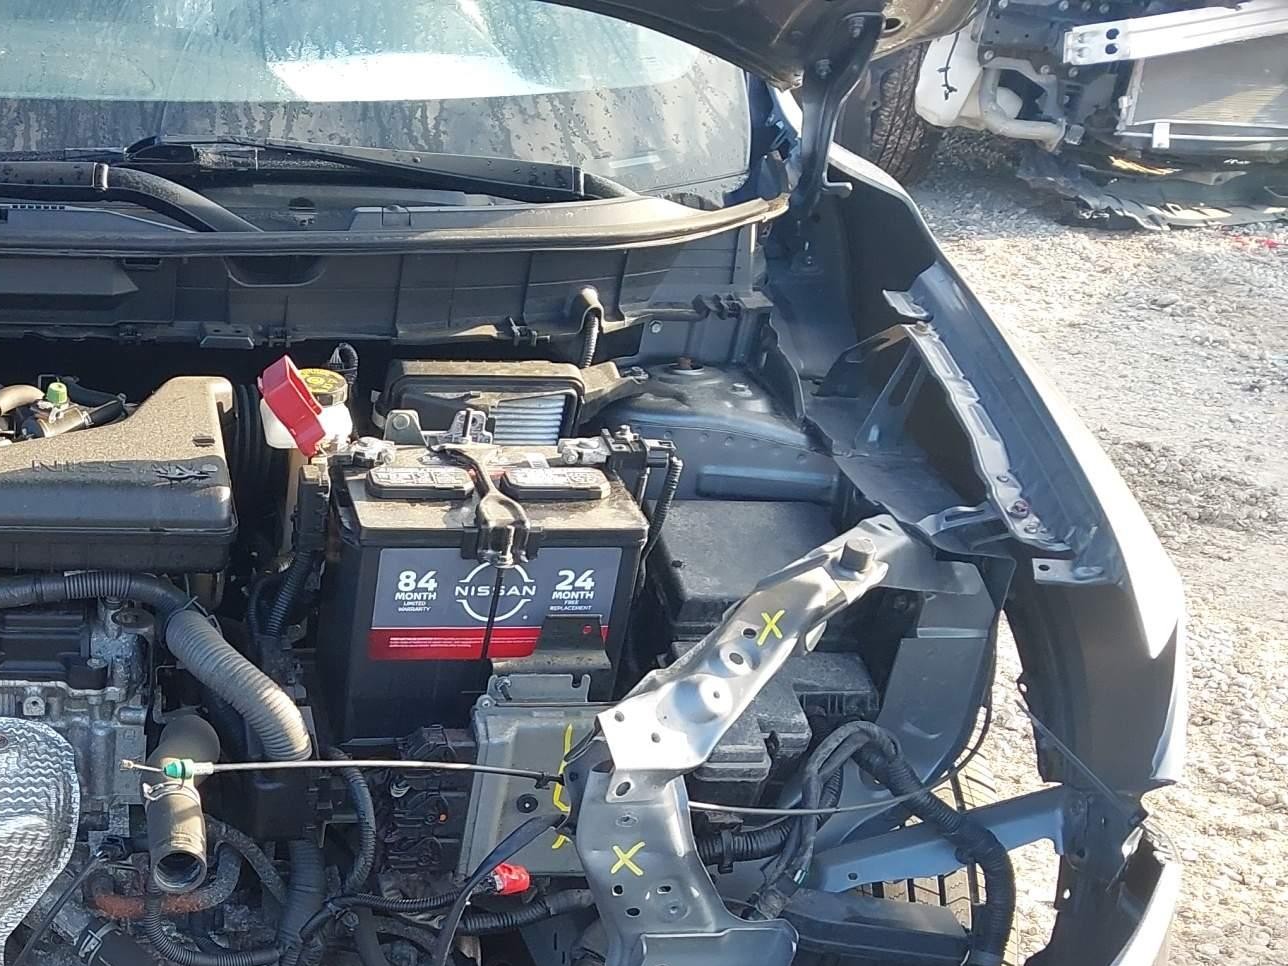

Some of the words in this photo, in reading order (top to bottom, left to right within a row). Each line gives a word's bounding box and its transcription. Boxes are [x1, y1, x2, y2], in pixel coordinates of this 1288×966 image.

[397, 570, 438, 592] 84
[555, 569, 595, 591] 24
[394, 591, 437, 601] MONTH
[454, 585, 537, 597] NISSAN
[551, 590, 594, 600] MONTH
